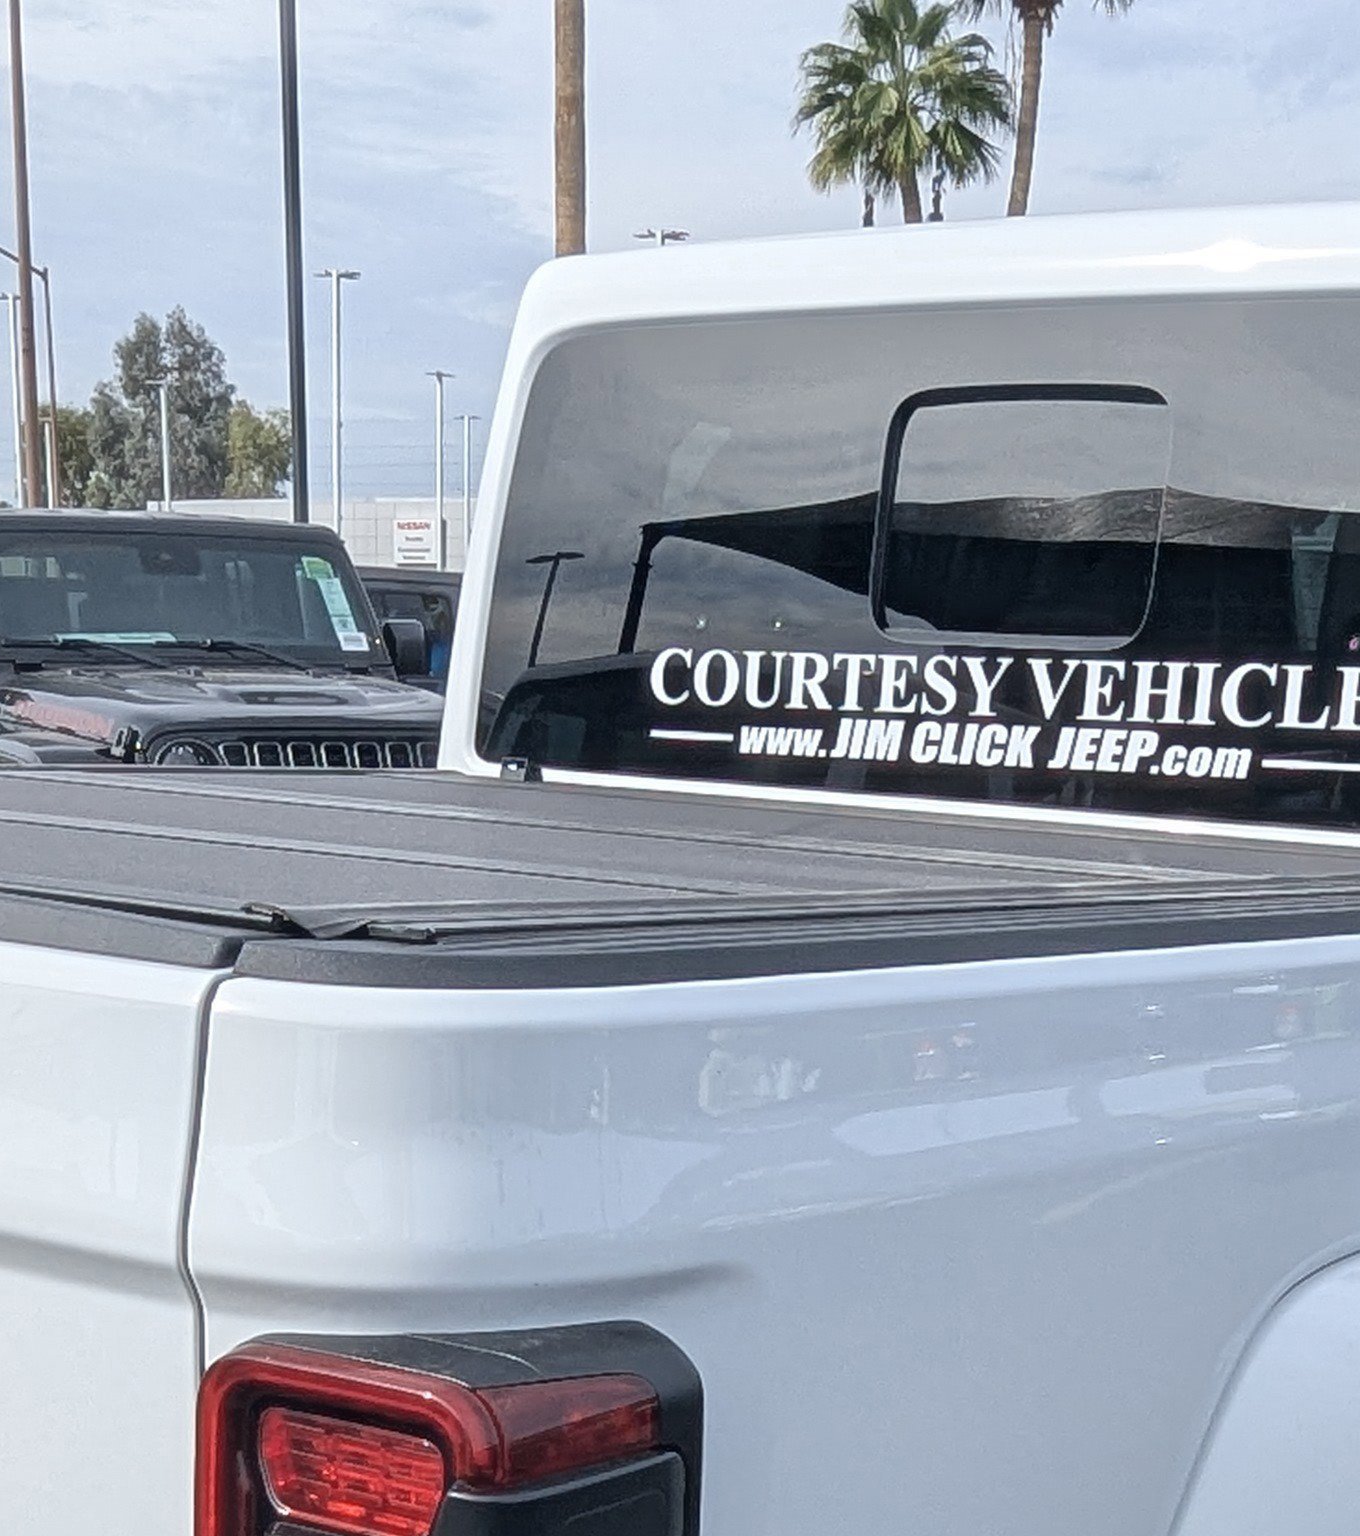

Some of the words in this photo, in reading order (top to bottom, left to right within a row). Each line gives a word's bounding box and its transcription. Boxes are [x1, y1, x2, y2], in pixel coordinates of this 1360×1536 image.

[649, 647, 1014, 717] COURTESY
[910, 720, 1041, 768] CLICK
[1046, 726, 1253, 779] JEEP.com
